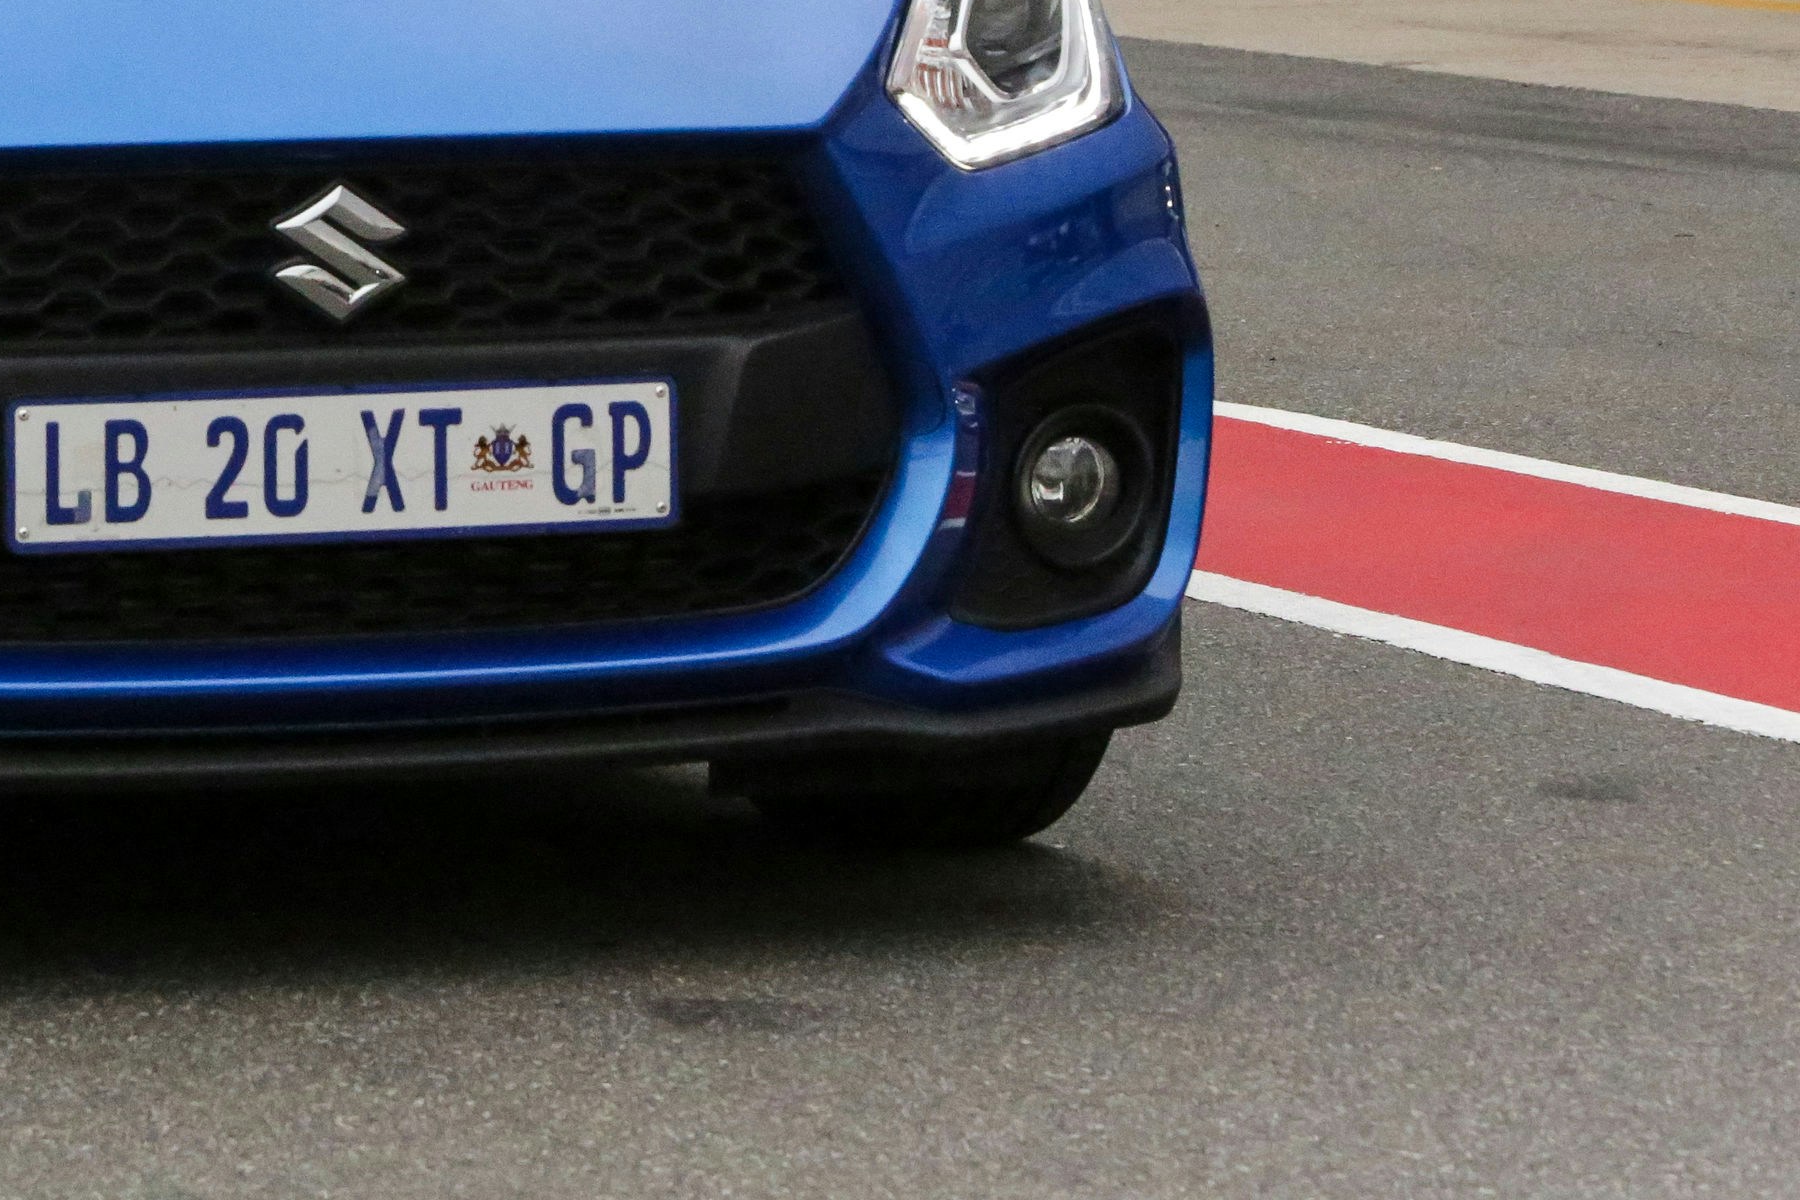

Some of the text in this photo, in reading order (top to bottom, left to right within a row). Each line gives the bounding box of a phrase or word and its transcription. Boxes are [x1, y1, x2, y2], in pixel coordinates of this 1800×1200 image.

[46, 401, 652, 525] LB 20 XT GP
[471, 479, 534, 492] GAUTENG
